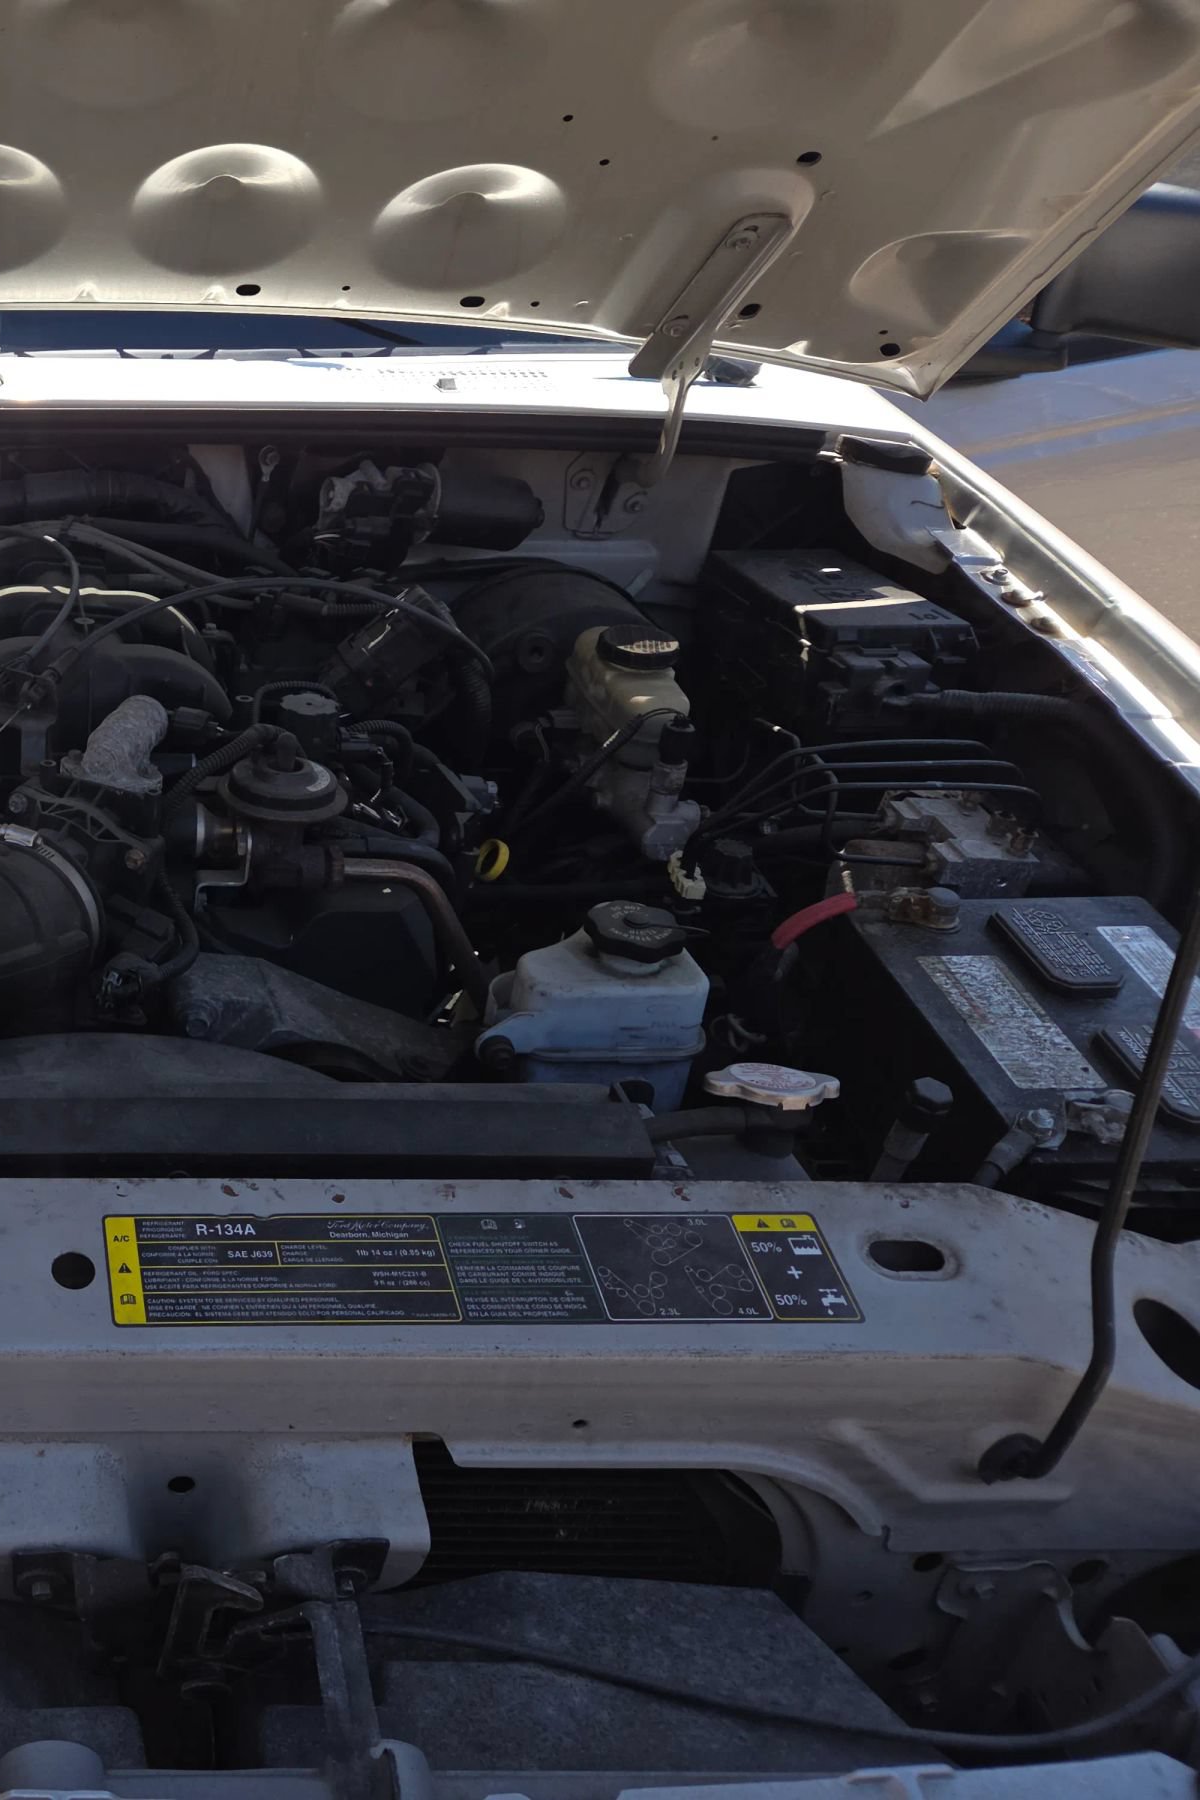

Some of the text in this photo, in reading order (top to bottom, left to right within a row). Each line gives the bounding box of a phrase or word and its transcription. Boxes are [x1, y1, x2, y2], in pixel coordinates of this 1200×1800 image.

[195, 1223, 257, 1236] R-134A
[371, 1231, 409, 1239] Michigan
[751, 1241, 783, 1254] 50%
[227, 1250, 273, 1258] SAE J639
[371, 1249, 381, 1257] 14
[382, 1249, 393, 1257] oz
[775, 1294, 808, 1306] 50%
[738, 1307, 760, 1315] 4.0L
